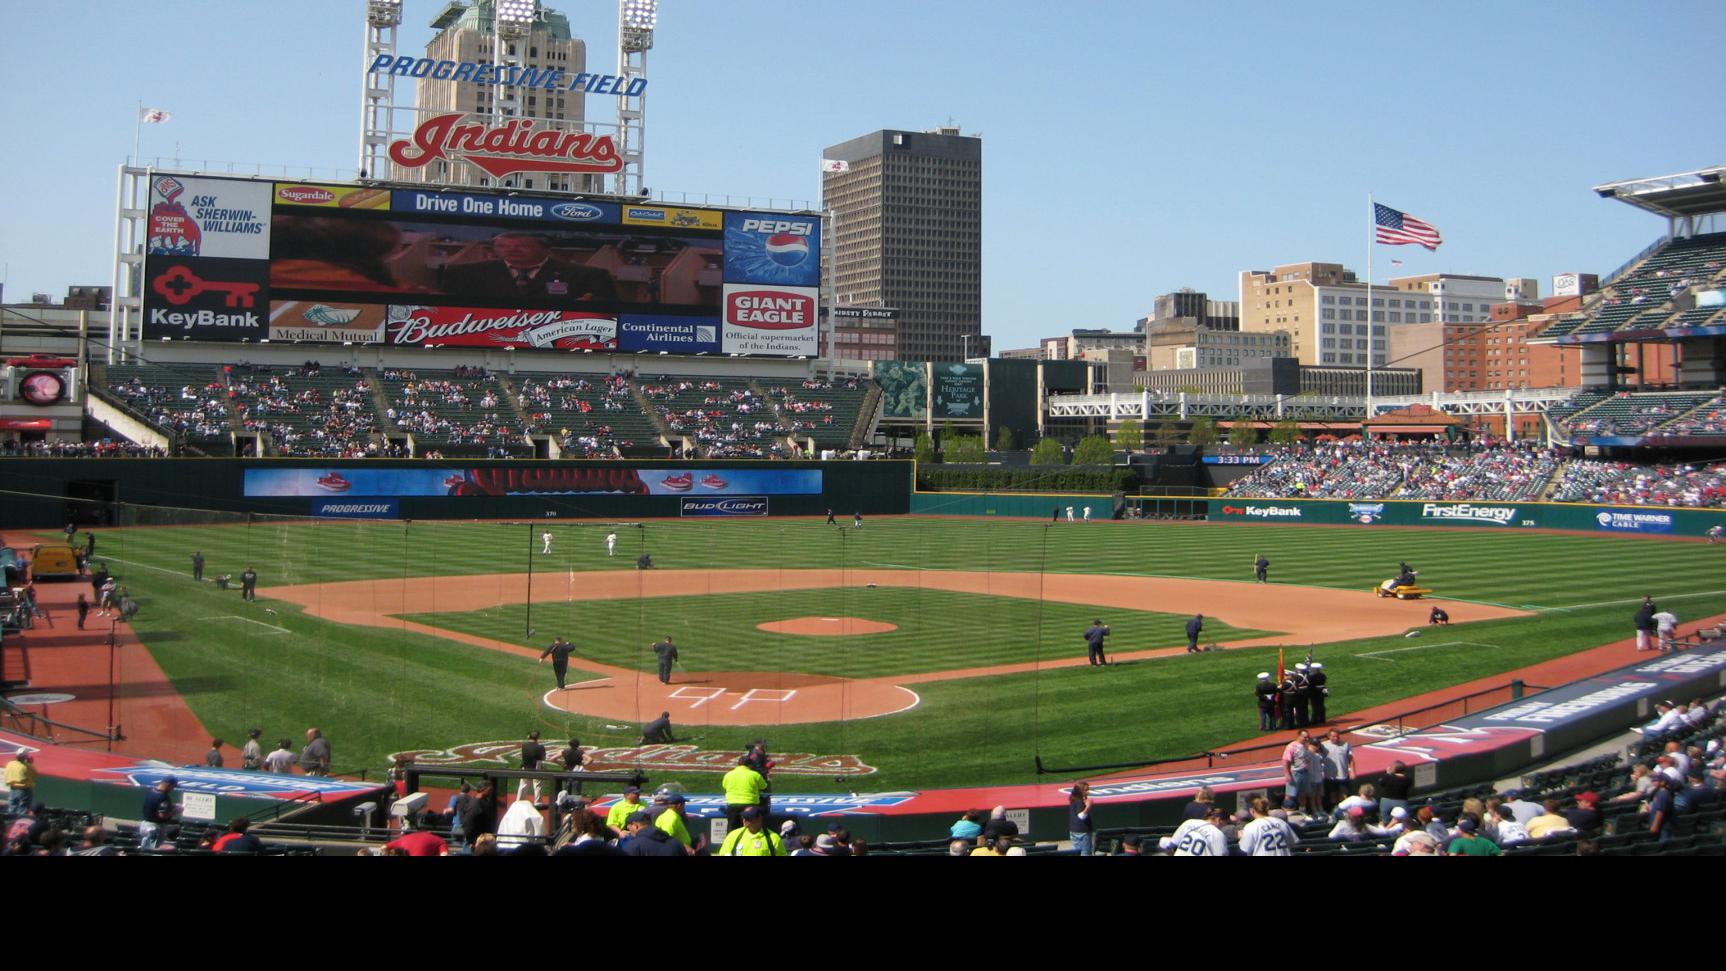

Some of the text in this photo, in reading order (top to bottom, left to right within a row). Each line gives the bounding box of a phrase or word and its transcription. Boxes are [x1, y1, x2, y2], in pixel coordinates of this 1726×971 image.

[368, 54, 648, 97] PROGRESSIVE FIELD
[389, 113, 624, 173] Indians
[191, 195, 217, 208] ASK
[281, 189, 334, 201] Sugardale
[416, 193, 543, 217] Drive One Home
[561, 204, 593, 218] Ford
[196, 207, 256, 222] SHERWIN-
[203, 220, 262, 234] WILLIAMS
[742, 219, 813, 235] PEPSI
[735, 296, 806, 311] GIANT
[151, 308, 259, 330] KeyBank
[736, 310, 804, 324] EAGLE
[388, 310, 562, 344] Budweiser
[535, 322, 614, 343] American Lager
[622, 322, 693, 334] Continental
[276, 328, 378, 342] Medical Mutual
[646, 332, 693, 343] Airlines
[726, 331, 814, 343] Official supermarket
[750, 342, 765, 350] the
[1217, 456, 1260, 464] 3:33 PM
[321, 504, 391, 513] PROGRESSIVE
[683, 502, 715, 510] BUD
[1245, 506, 1301, 517] KeyBank
[1422, 503, 1516, 520] FirstEnergy
[1611, 512, 1671, 523] TIME WARNER
[1611, 521, 1639, 529] CABLE
[1178, 834, 1206, 856] 20
[1262, 831, 1287, 851] 22
